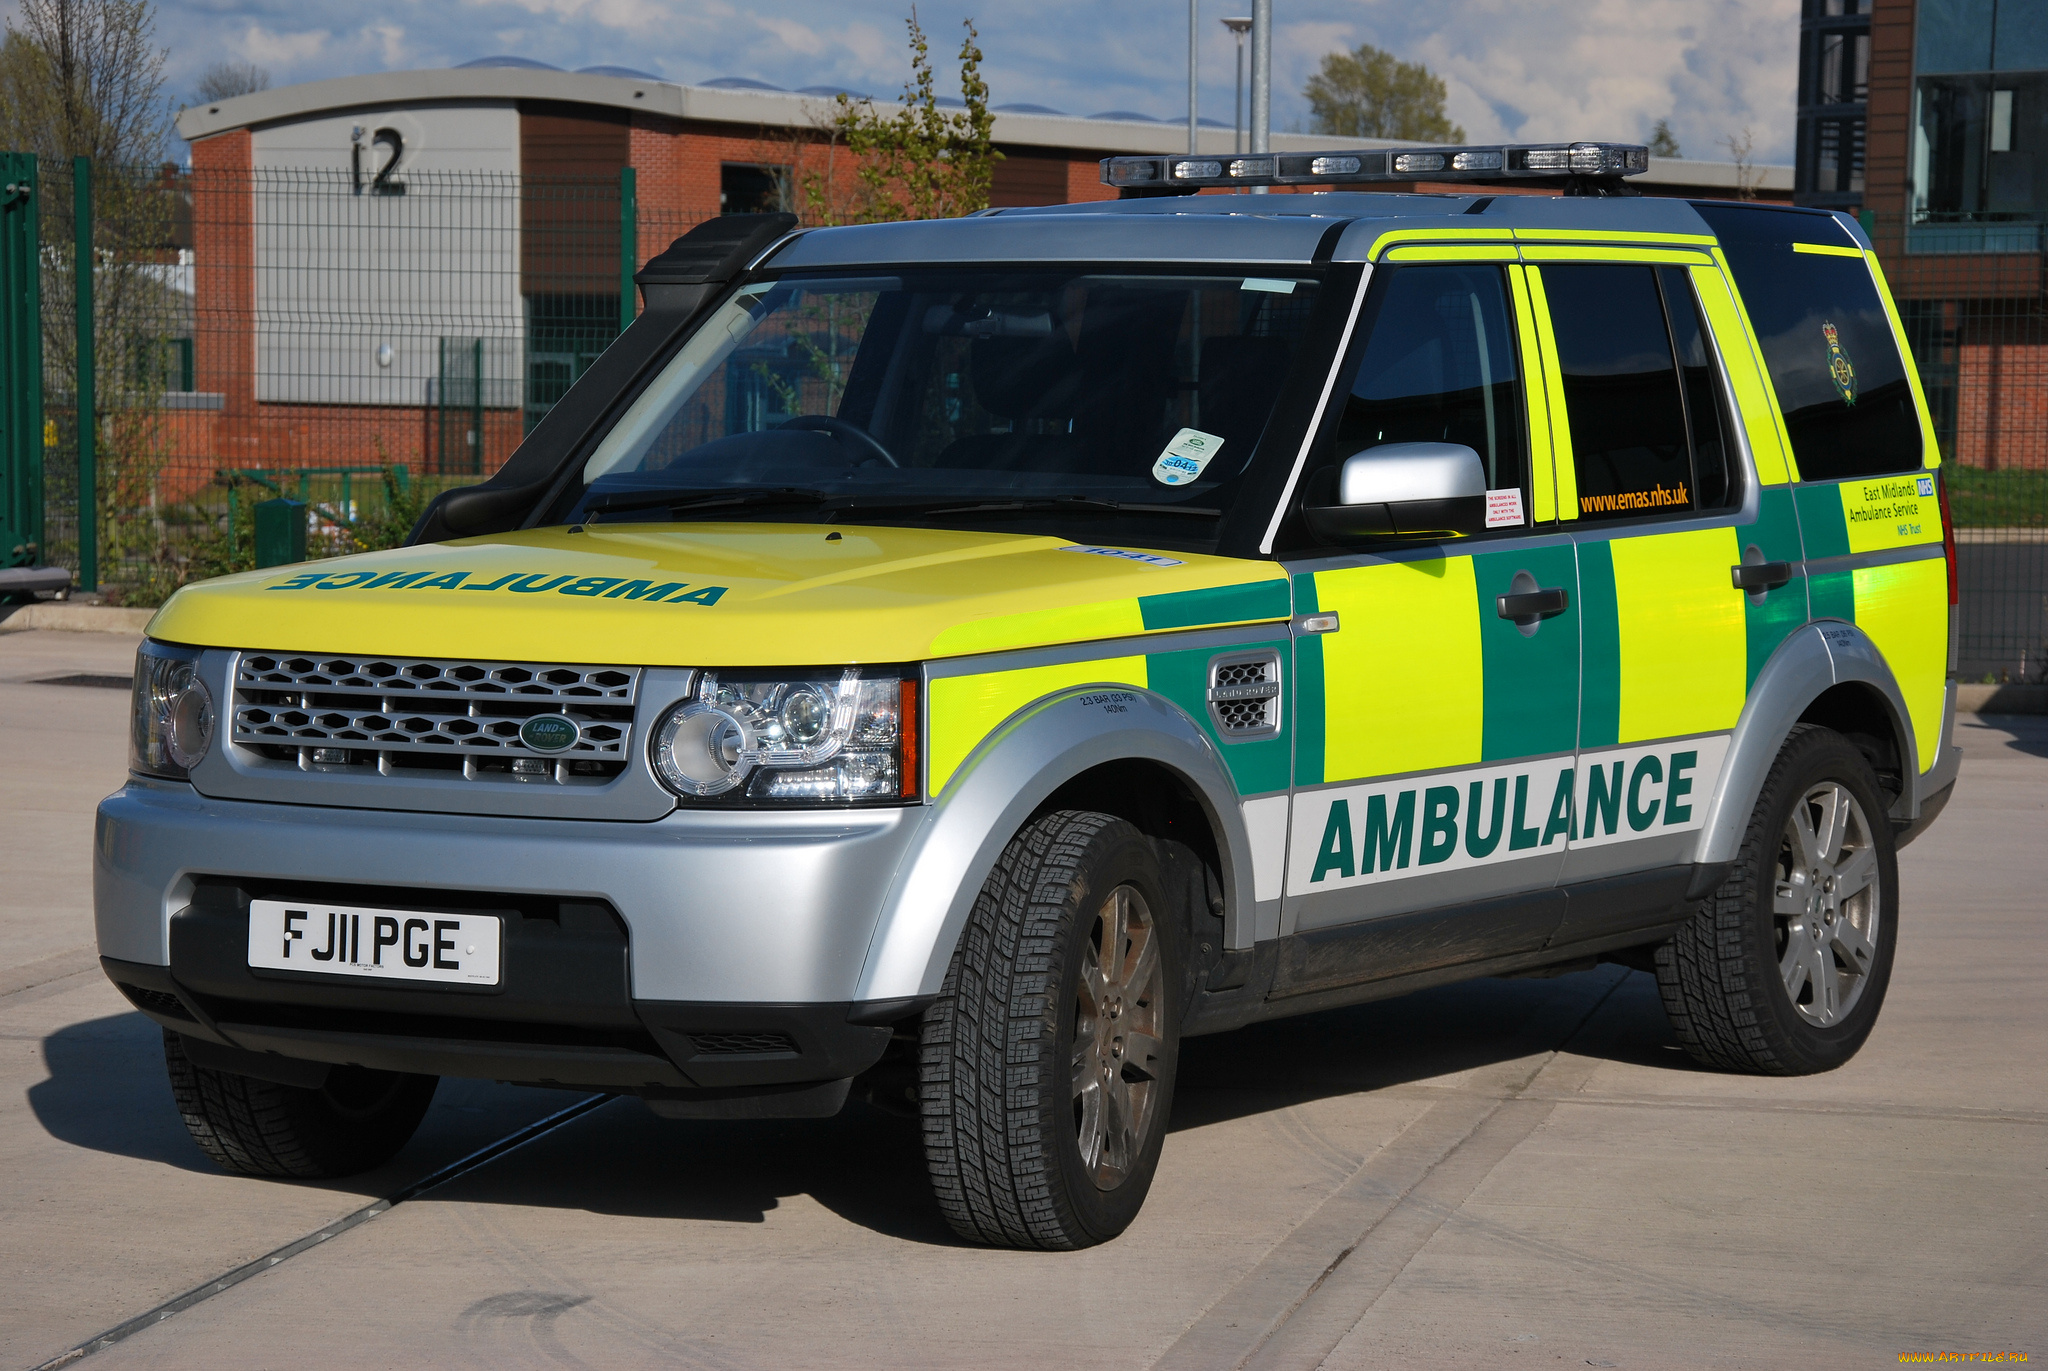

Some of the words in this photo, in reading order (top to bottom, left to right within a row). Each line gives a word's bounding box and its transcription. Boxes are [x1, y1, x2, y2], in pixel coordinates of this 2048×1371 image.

[1173, 459, 1189, 470] 04
[1863, 486, 1881, 502] East
[1881, 481, 1915, 499] Midlands
[1917, 479, 1933, 496] NHS
[1580, 481, 1689, 513] www.emas.nhs.uk
[1849, 504, 1892, 523] Ambulance
[1892, 501, 1919, 518] Service
[1897, 524, 1909, 537] NHS
[1909, 523, 1922, 535] Trust
[1216, 689, 1242, 698] LAND
[1246, 686, 1277, 696] ROVER
[1080, 696, 1094, 706] 2.3
[1093, 694, 1111, 704] BAR
[532, 722, 560, 733] LAND
[534, 732, 567, 743] ROVER
[1309, 750, 1698, 884] AMBULANCE
[373, 915, 461, 971] PGE
